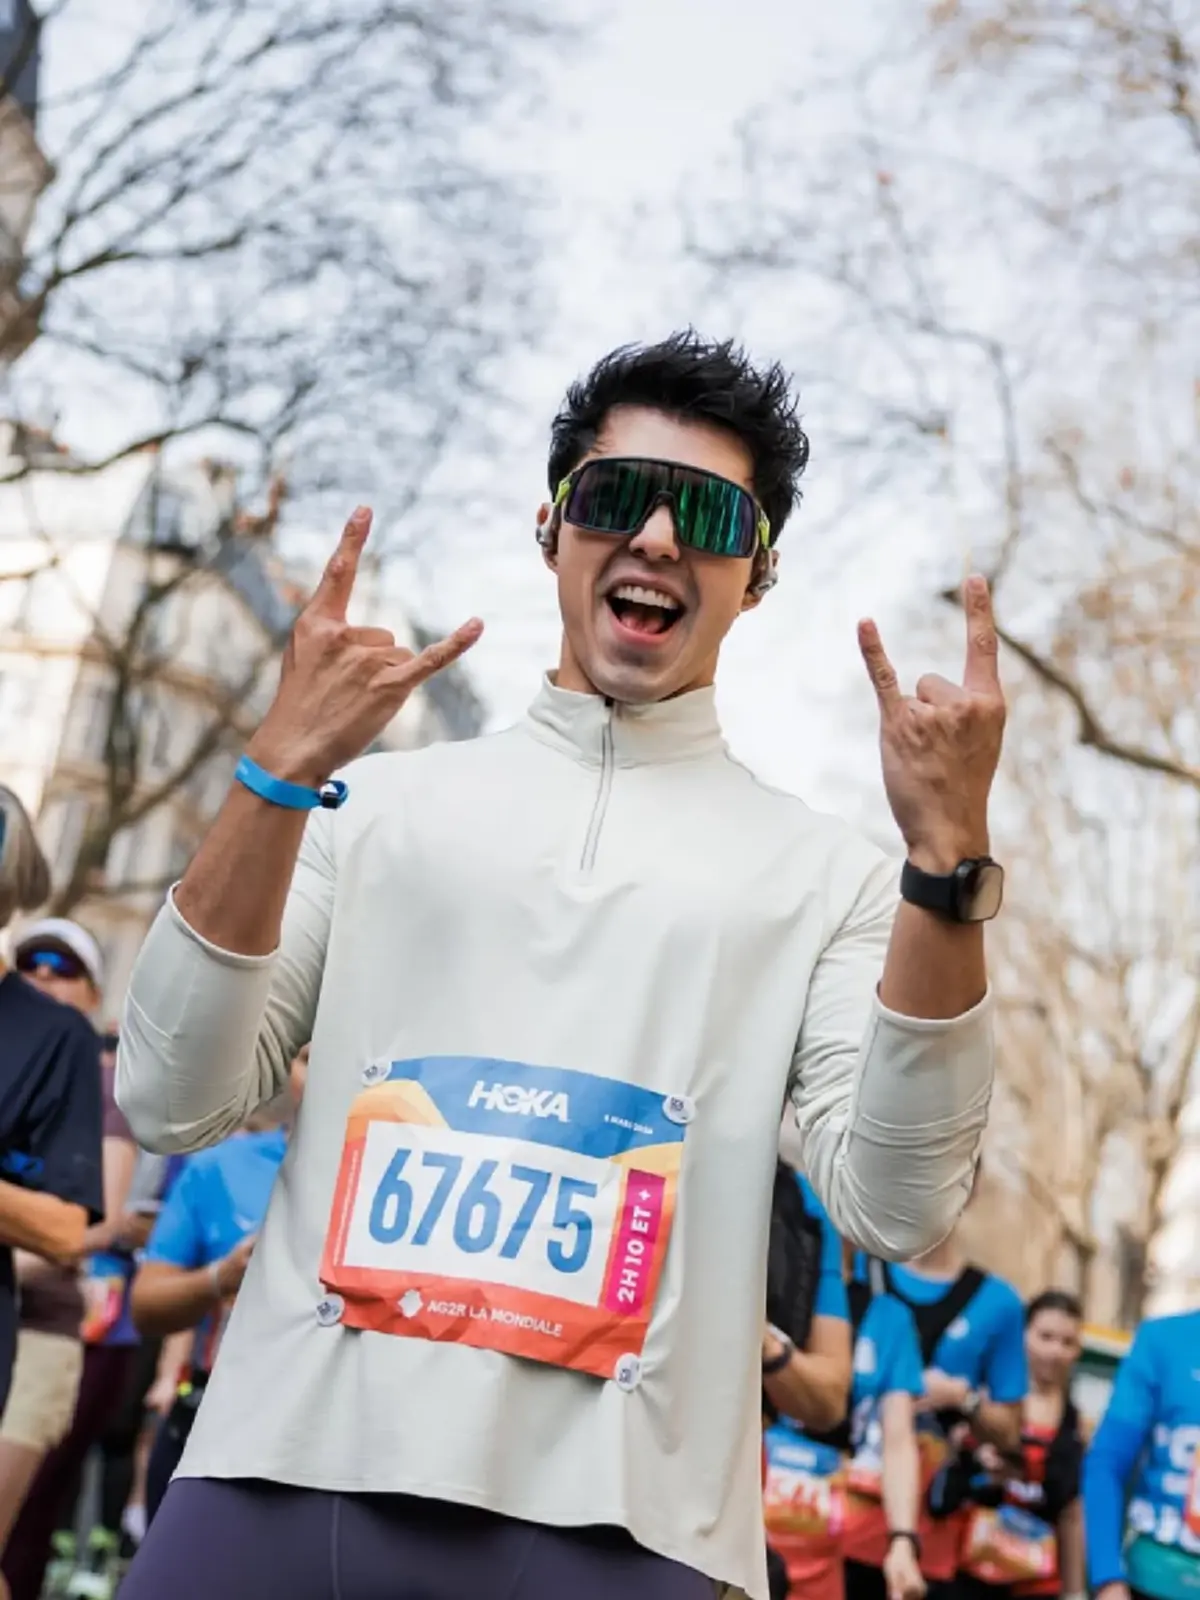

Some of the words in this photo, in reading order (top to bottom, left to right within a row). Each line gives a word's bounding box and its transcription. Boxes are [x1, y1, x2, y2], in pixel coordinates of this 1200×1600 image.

[467, 1079, 571, 1123] HOKA
[368, 1147, 599, 1274] 67675
[630, 1205, 652, 1234] ET
[426, 1299, 467, 1317] AG2R
[469, 1306, 488, 1321] LA
[490, 1308, 564, 1338] MONDIALE
